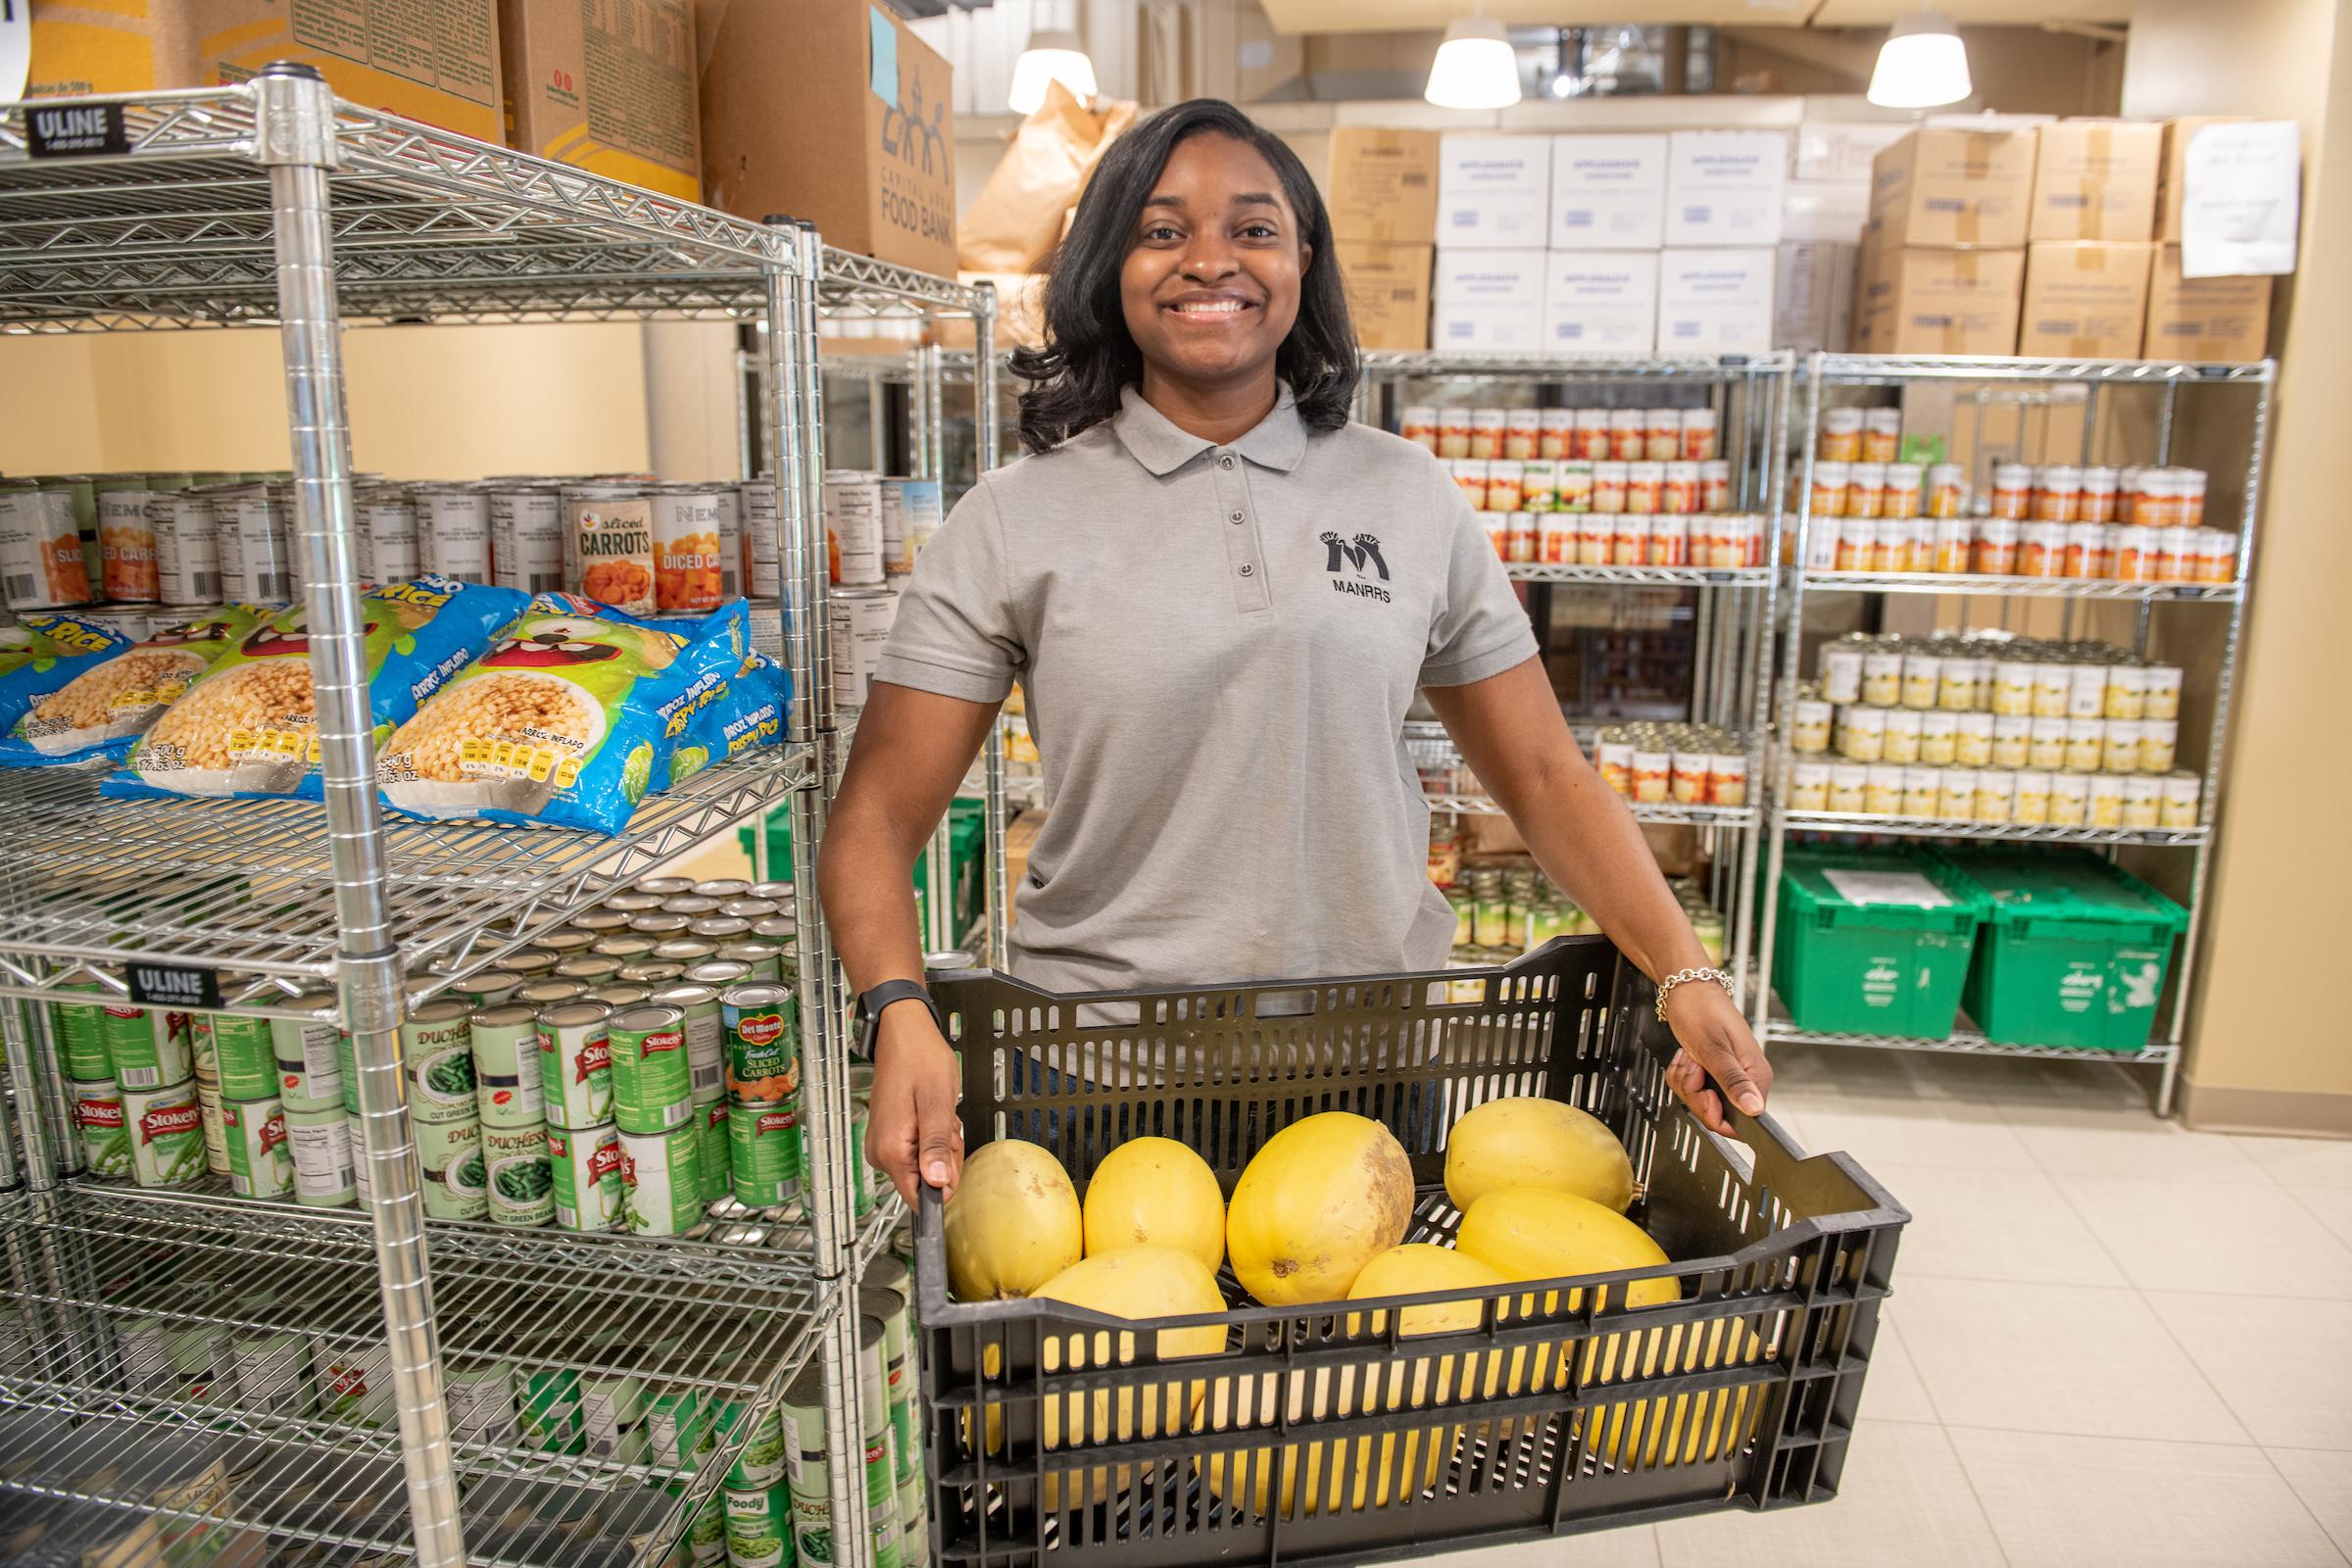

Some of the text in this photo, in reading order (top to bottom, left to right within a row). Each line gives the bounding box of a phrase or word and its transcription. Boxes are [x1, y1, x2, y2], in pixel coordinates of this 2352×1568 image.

[36, 107, 108, 139] ULINE
[881, 187, 952, 245] FOOD BANK
[602, 515, 643, 529] sliced
[580, 530, 649, 556] CARROTS
[663, 555, 703, 569] DICED
[1333, 579, 1391, 604] MANRRS
[45, 621, 114, 652] RICE
[283, 713, 310, 724] ARROZ
[551, 734, 584, 750] INFLADO
[153, 745, 186, 760] 500 g
[138, 759, 188, 772] 17.63 oz
[403, 769, 418, 782] oz
[137, 968, 203, 995] ULINE
[742, 1021, 781, 1035] Del Monte
[764, 1048, 781, 1056] Cut
[747, 1056, 780, 1068] SLICED
[742, 1064, 785, 1078] CARROTS
[447, 1107, 469, 1119] GREEN
[461, 1206, 474, 1215] CUT
[510, 1212, 534, 1223] GREEN
[727, 1495, 764, 1510] Foody
